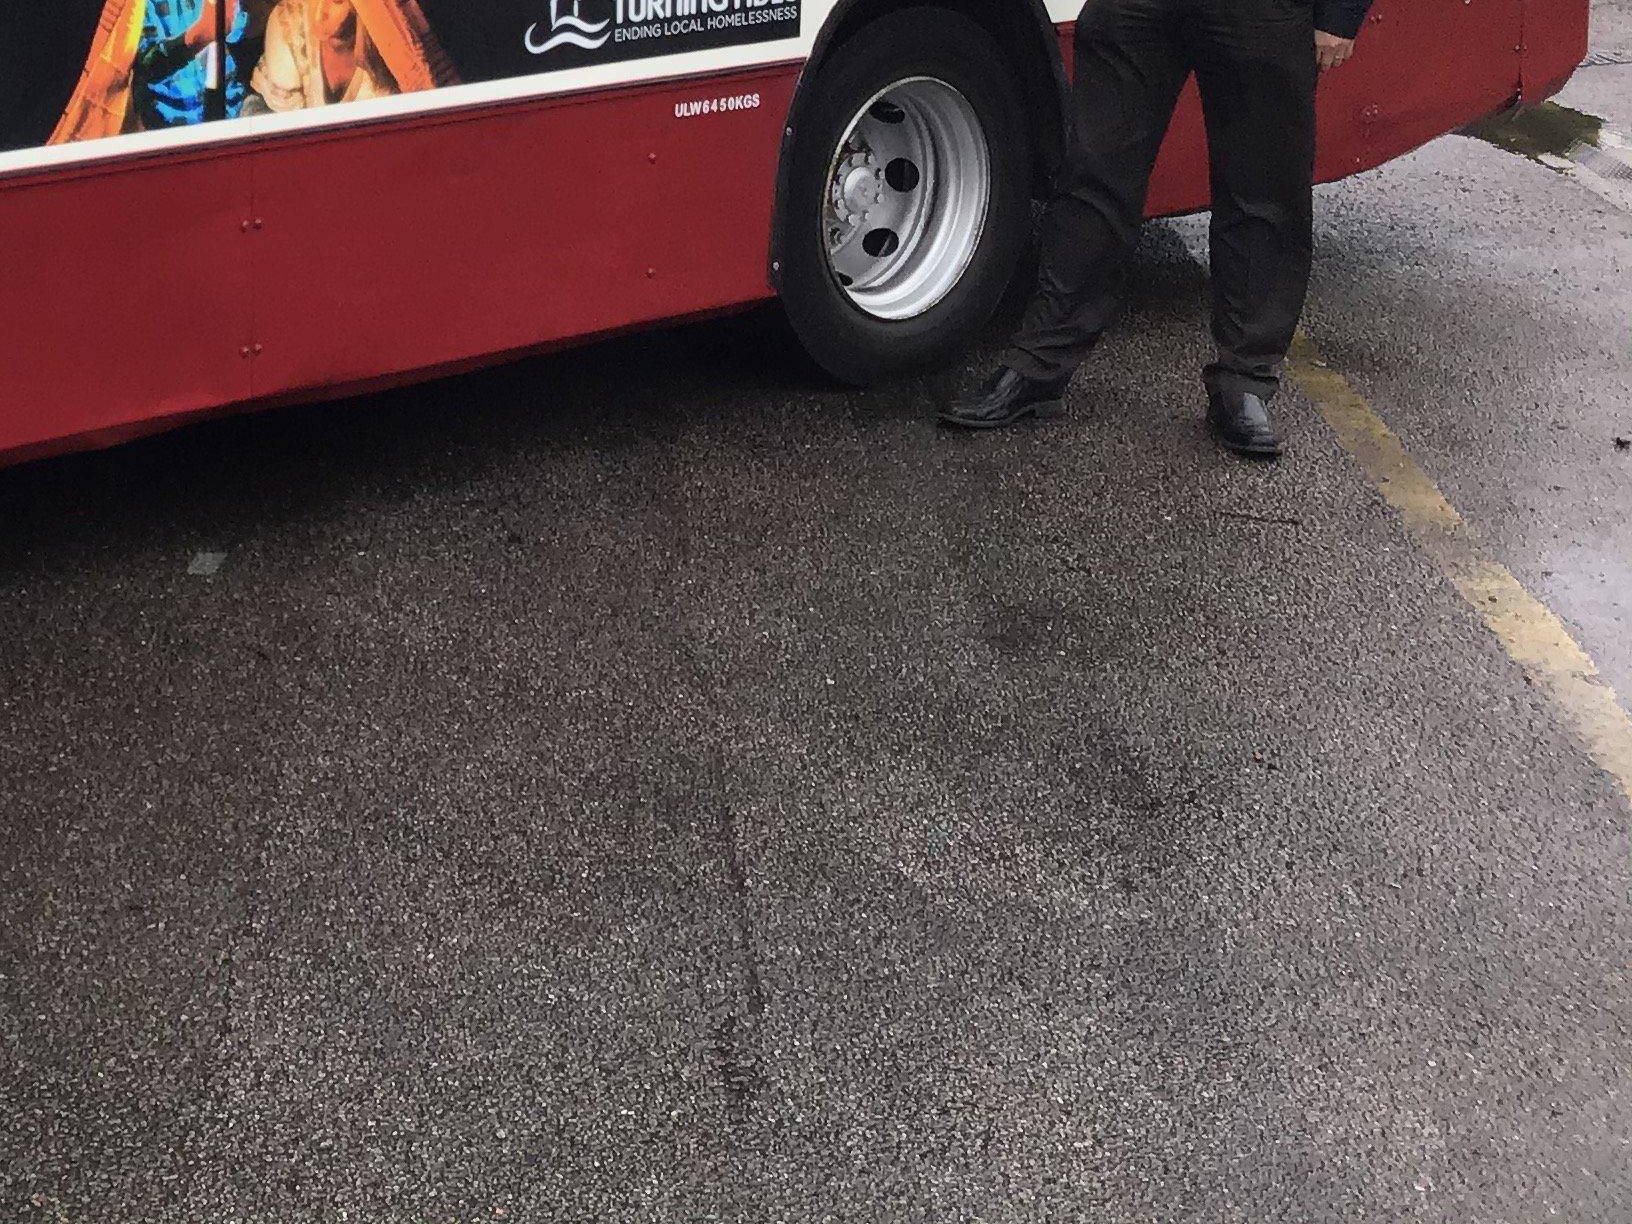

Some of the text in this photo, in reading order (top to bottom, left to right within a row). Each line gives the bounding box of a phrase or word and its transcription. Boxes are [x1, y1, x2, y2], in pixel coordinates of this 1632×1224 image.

[614, 6, 798, 43] ENDING LOCAL HOMELESSNESS
